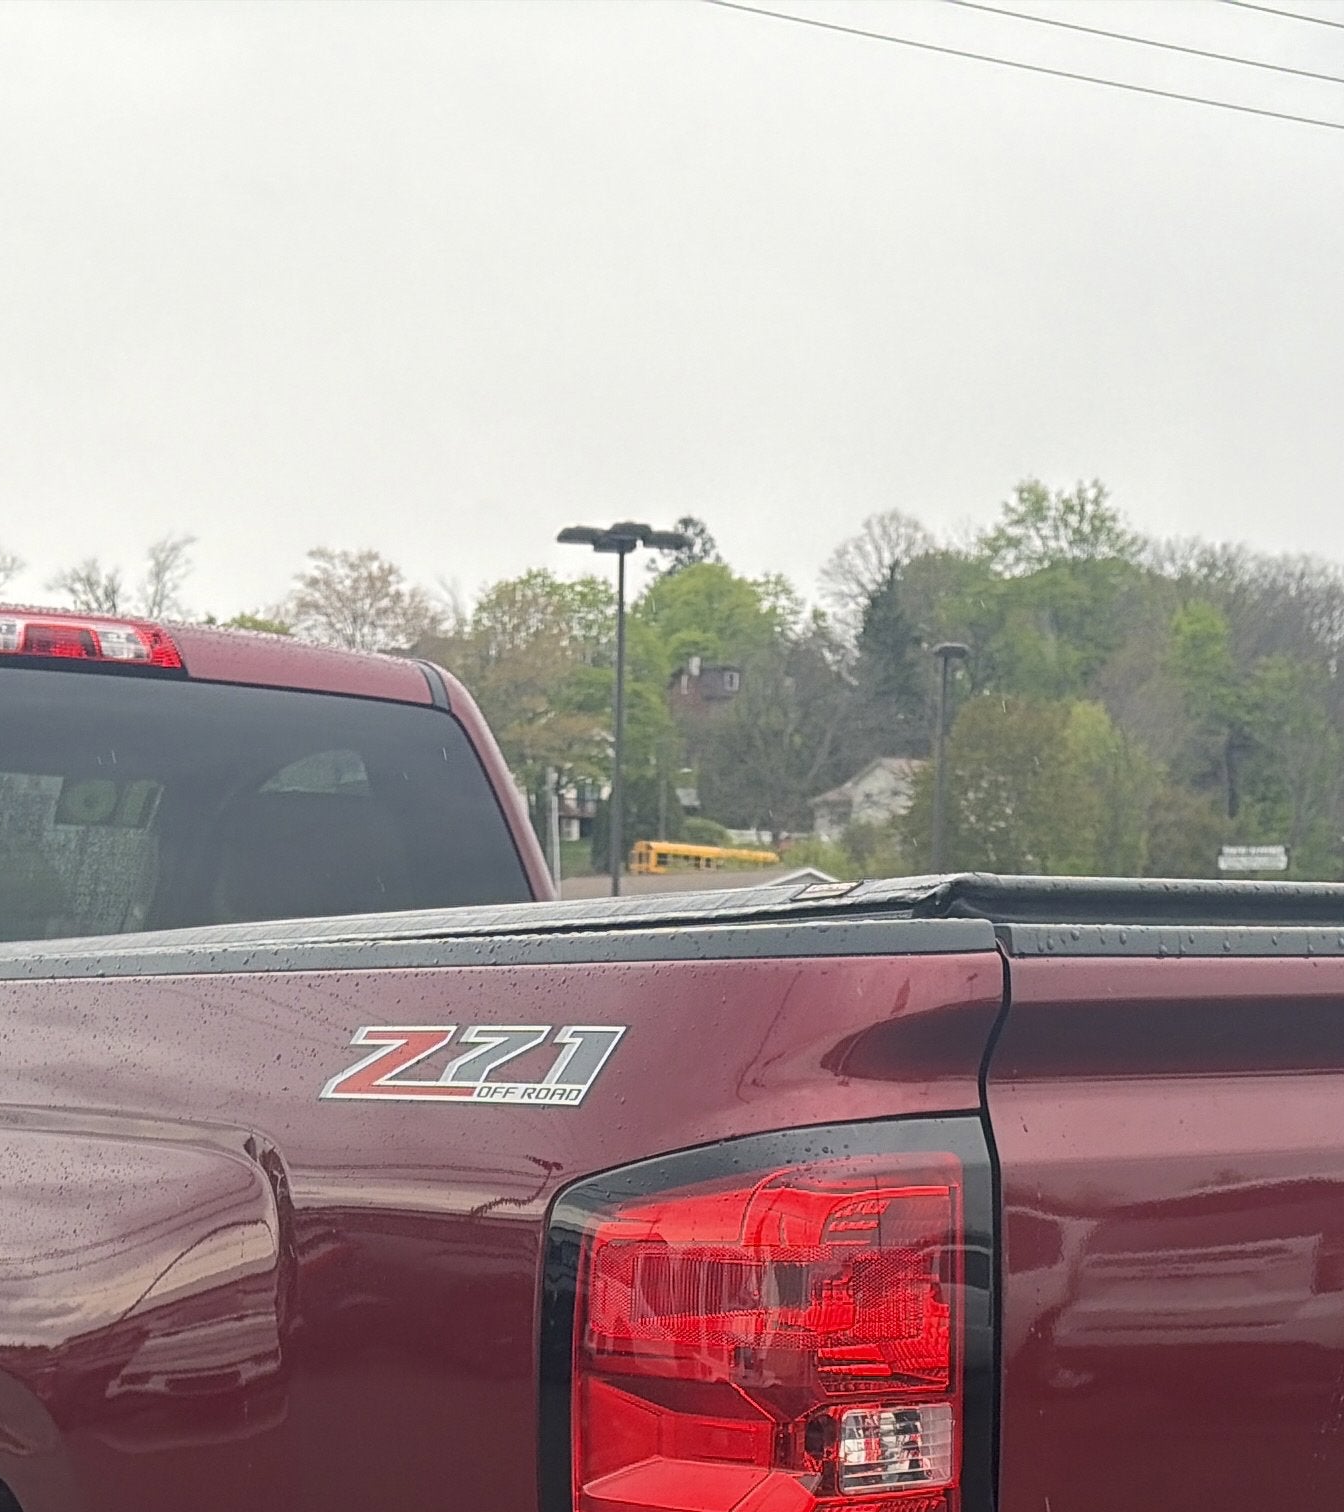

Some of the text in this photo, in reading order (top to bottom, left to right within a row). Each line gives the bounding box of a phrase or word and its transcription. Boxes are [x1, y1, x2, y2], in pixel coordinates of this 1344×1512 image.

[319, 1025, 628, 1105] Z71
[477, 1086, 582, 1102] OFF ROAD
